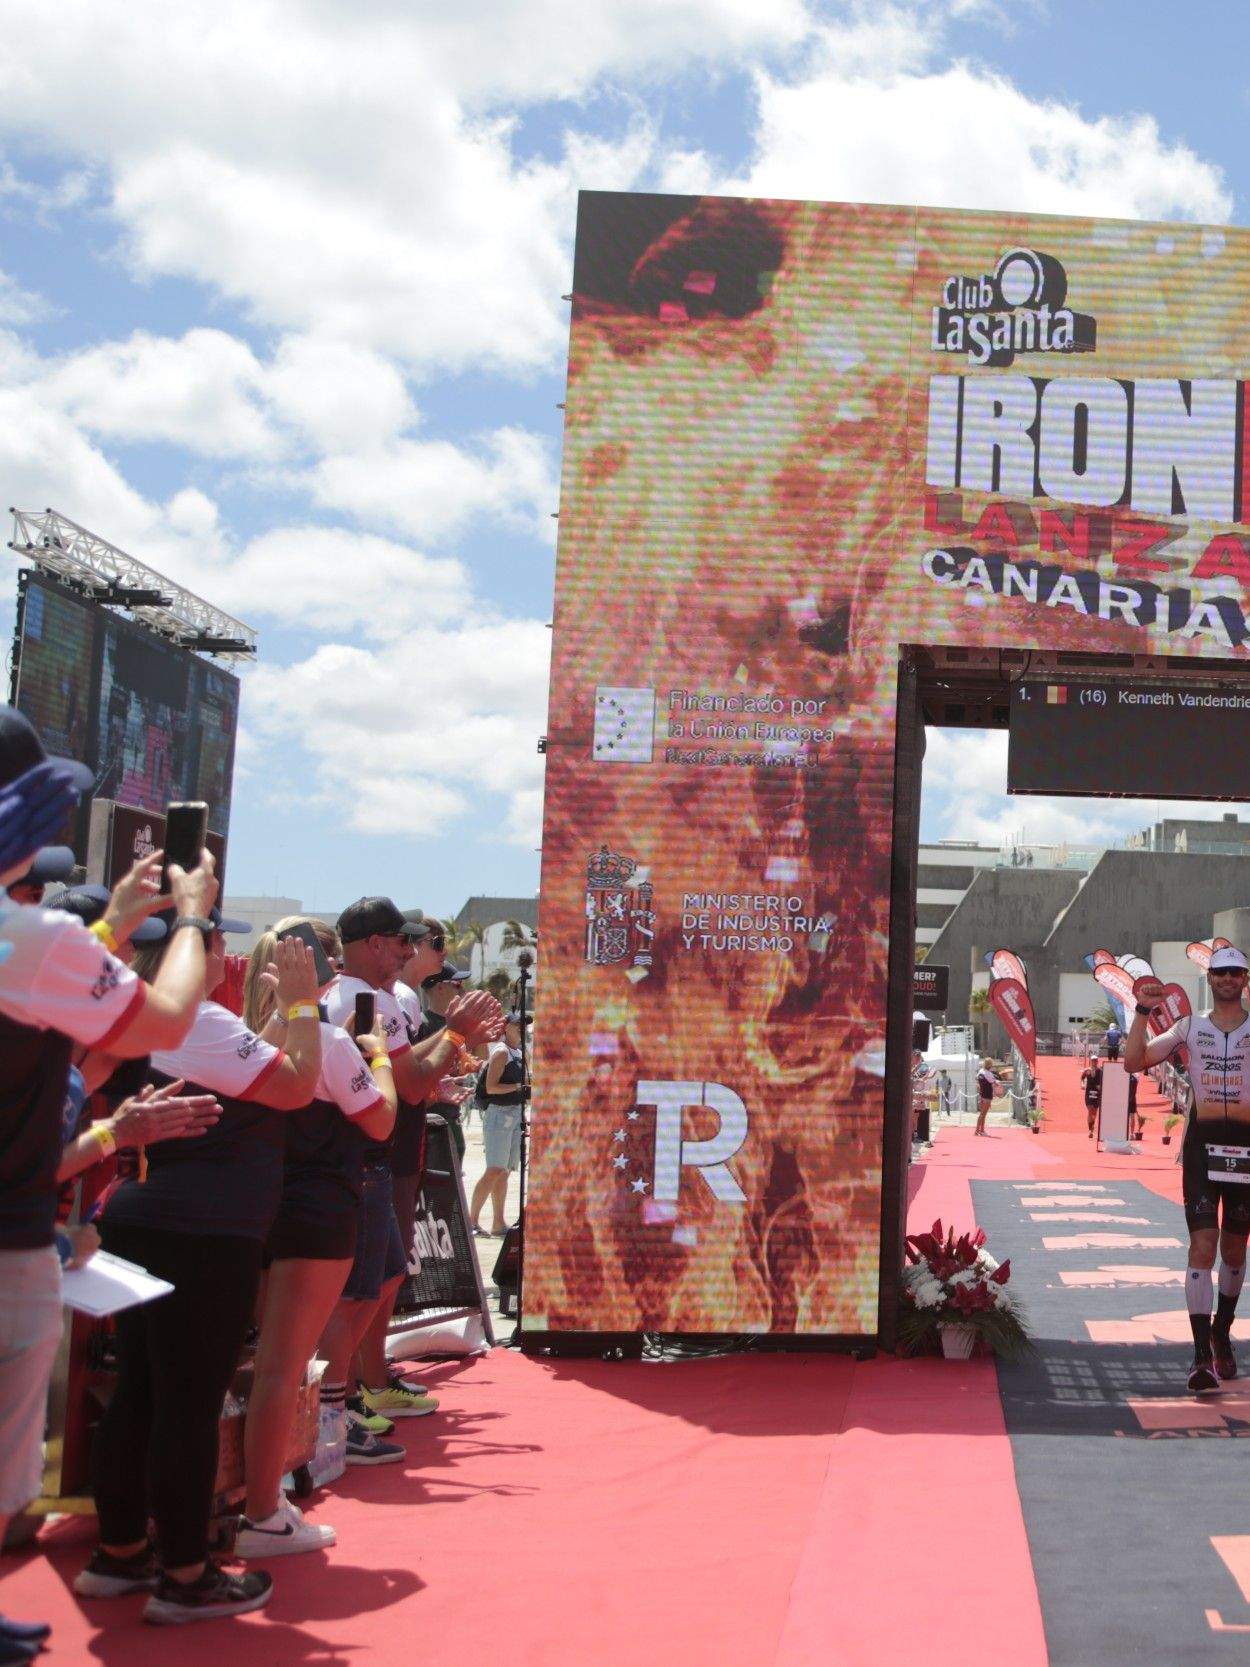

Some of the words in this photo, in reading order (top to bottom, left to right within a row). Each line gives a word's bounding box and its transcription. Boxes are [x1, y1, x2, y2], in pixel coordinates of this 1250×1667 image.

[943, 275, 994, 310] Club
[669, 689, 784, 714] Financiado
[791, 700, 826, 717] por
[1018, 688, 1031, 701] 1.
[1079, 689, 1107, 706] (16)
[1118, 690, 1174, 706] Kenneth
[669, 720, 684, 738] la
[690, 720, 749, 740] Unión
[754, 721, 835, 746] Europea
[683, 893, 802, 912] MINISTERIO
[682, 914, 710, 930] DE
[682, 934, 695, 950] Y
[700, 934, 793, 952] TURISMO
[1224, 1158, 1237, 1168] 15
